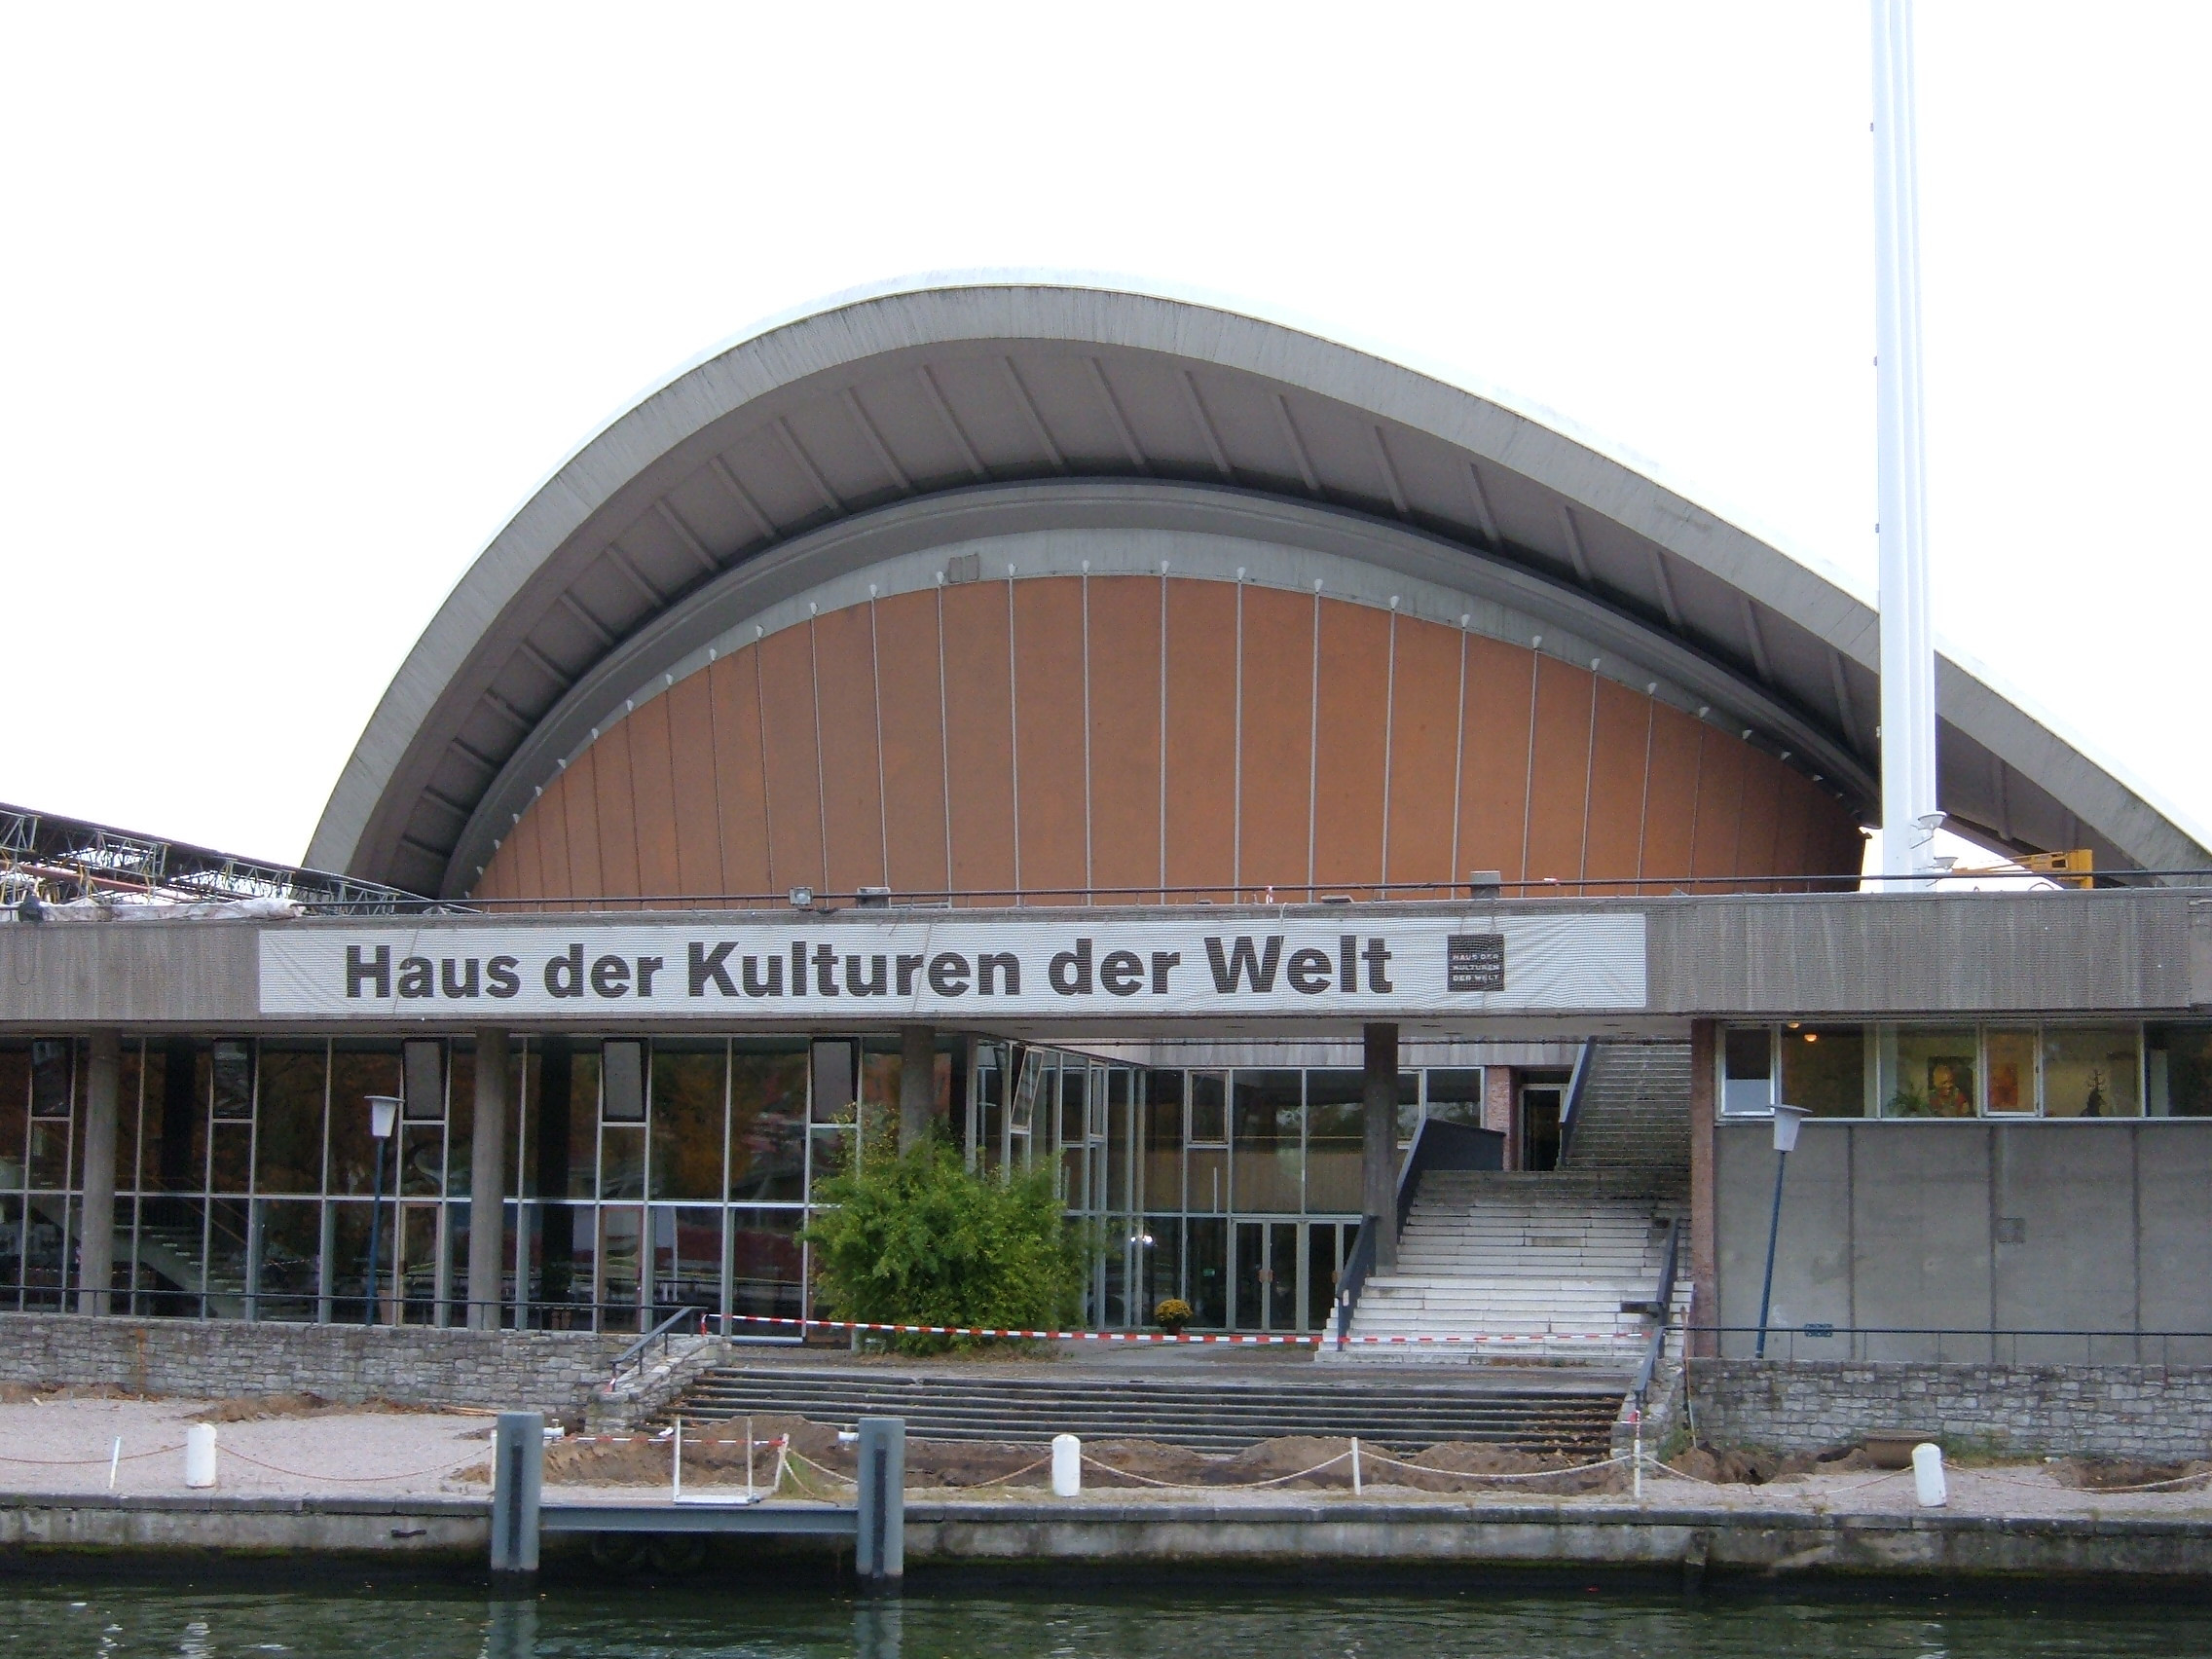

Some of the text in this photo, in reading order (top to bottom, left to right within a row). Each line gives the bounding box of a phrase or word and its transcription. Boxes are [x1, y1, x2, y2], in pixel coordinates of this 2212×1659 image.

[346, 935, 1393, 999] Haus der Kulturen der Welt
